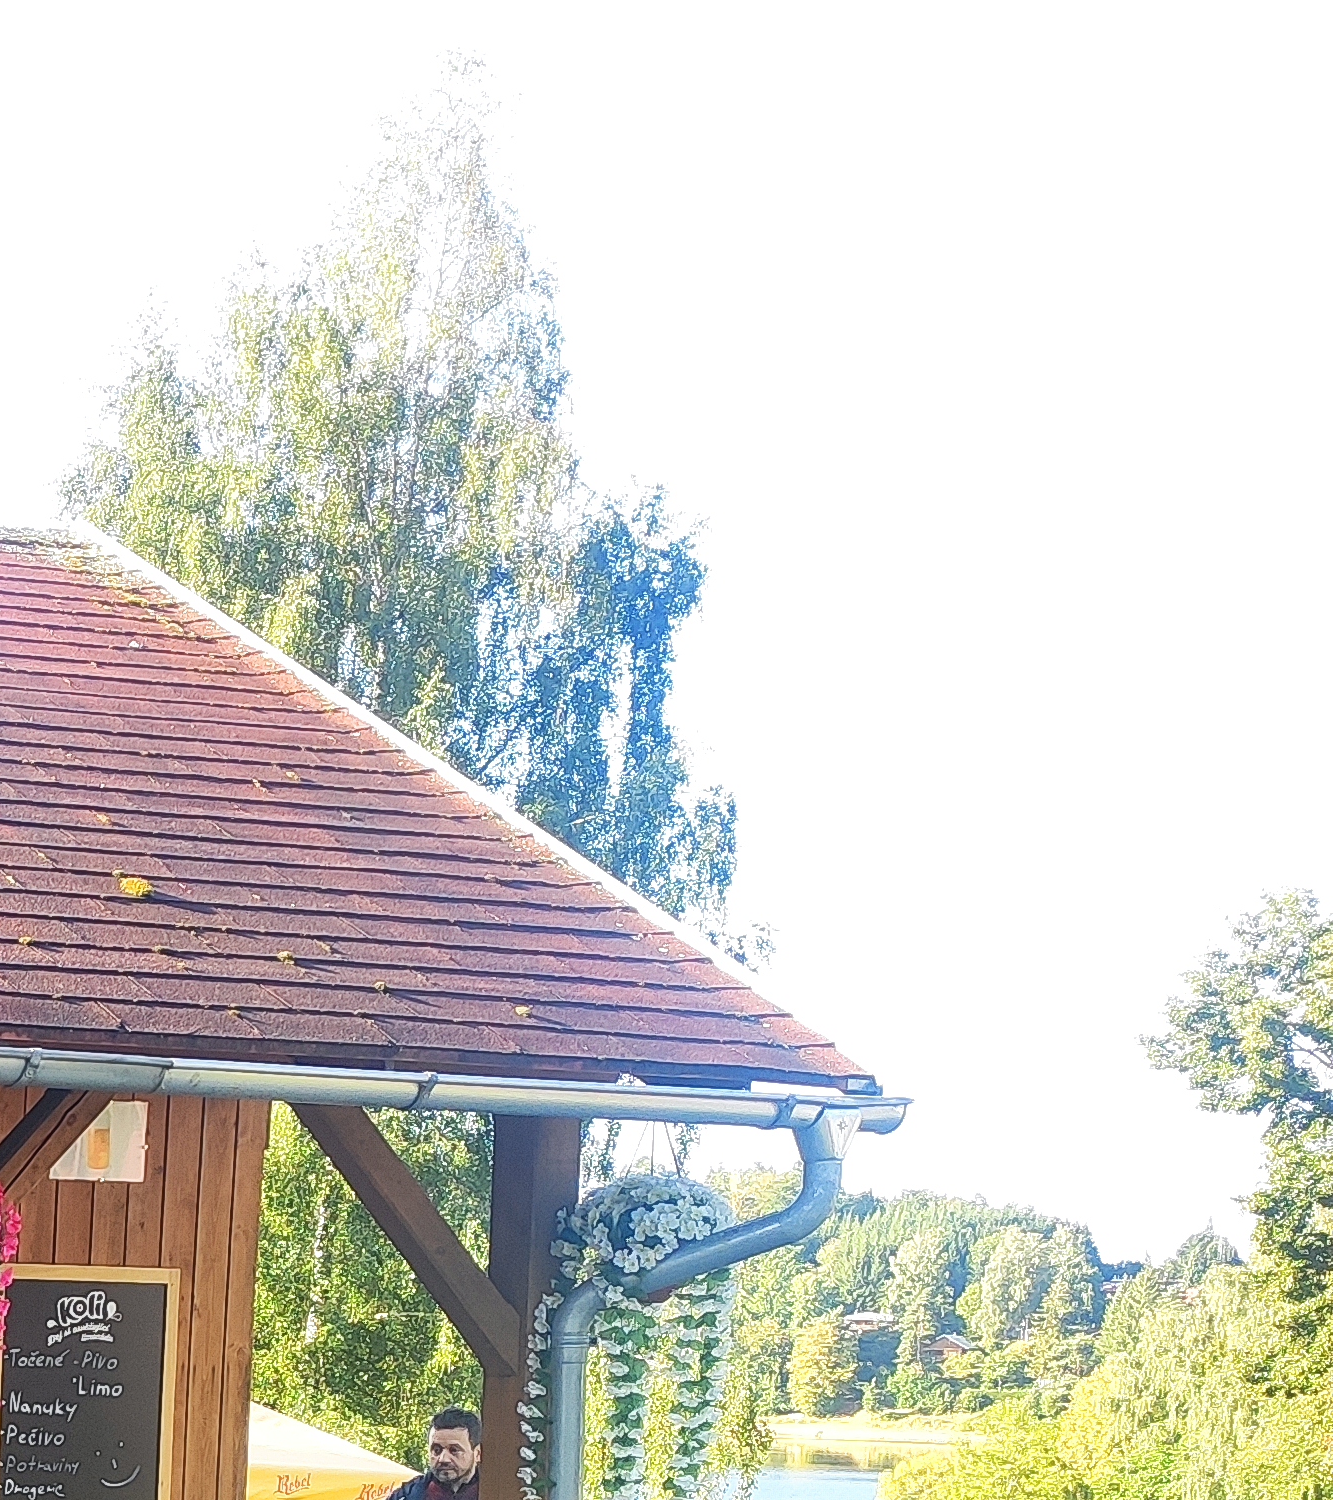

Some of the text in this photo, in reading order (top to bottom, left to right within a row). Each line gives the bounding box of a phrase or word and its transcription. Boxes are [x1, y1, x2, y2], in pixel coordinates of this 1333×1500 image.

[78, 1375, 123, 1397] Limo
[8, 1390, 79, 1423] Nanuky
[5, 1424, 66, 1446] Pečivo
[5, 1454, 81, 1475] Potraviny
